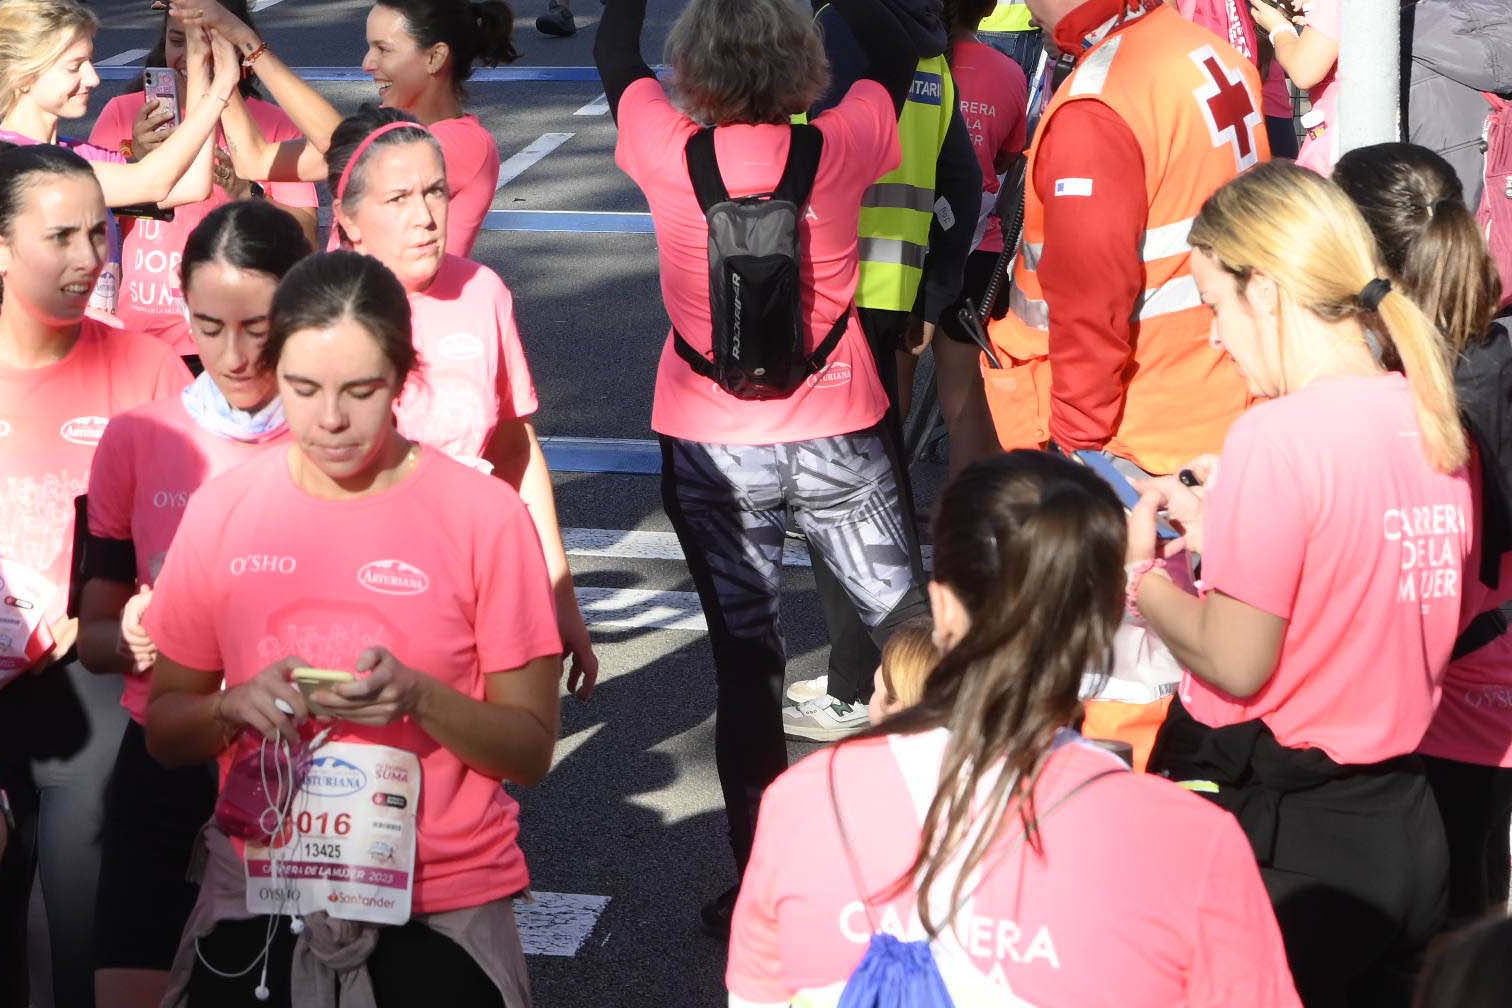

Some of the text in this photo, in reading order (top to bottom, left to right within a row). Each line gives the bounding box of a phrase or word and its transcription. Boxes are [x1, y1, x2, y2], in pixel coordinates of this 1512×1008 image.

[362, 569, 425, 591] ASTURIANA
[296, 810, 352, 838] 016
[304, 842, 342, 859] 13425
[304, 865, 319, 878] DE
[319, 866, 331, 878] LA
[338, 891, 396, 910] Santander
